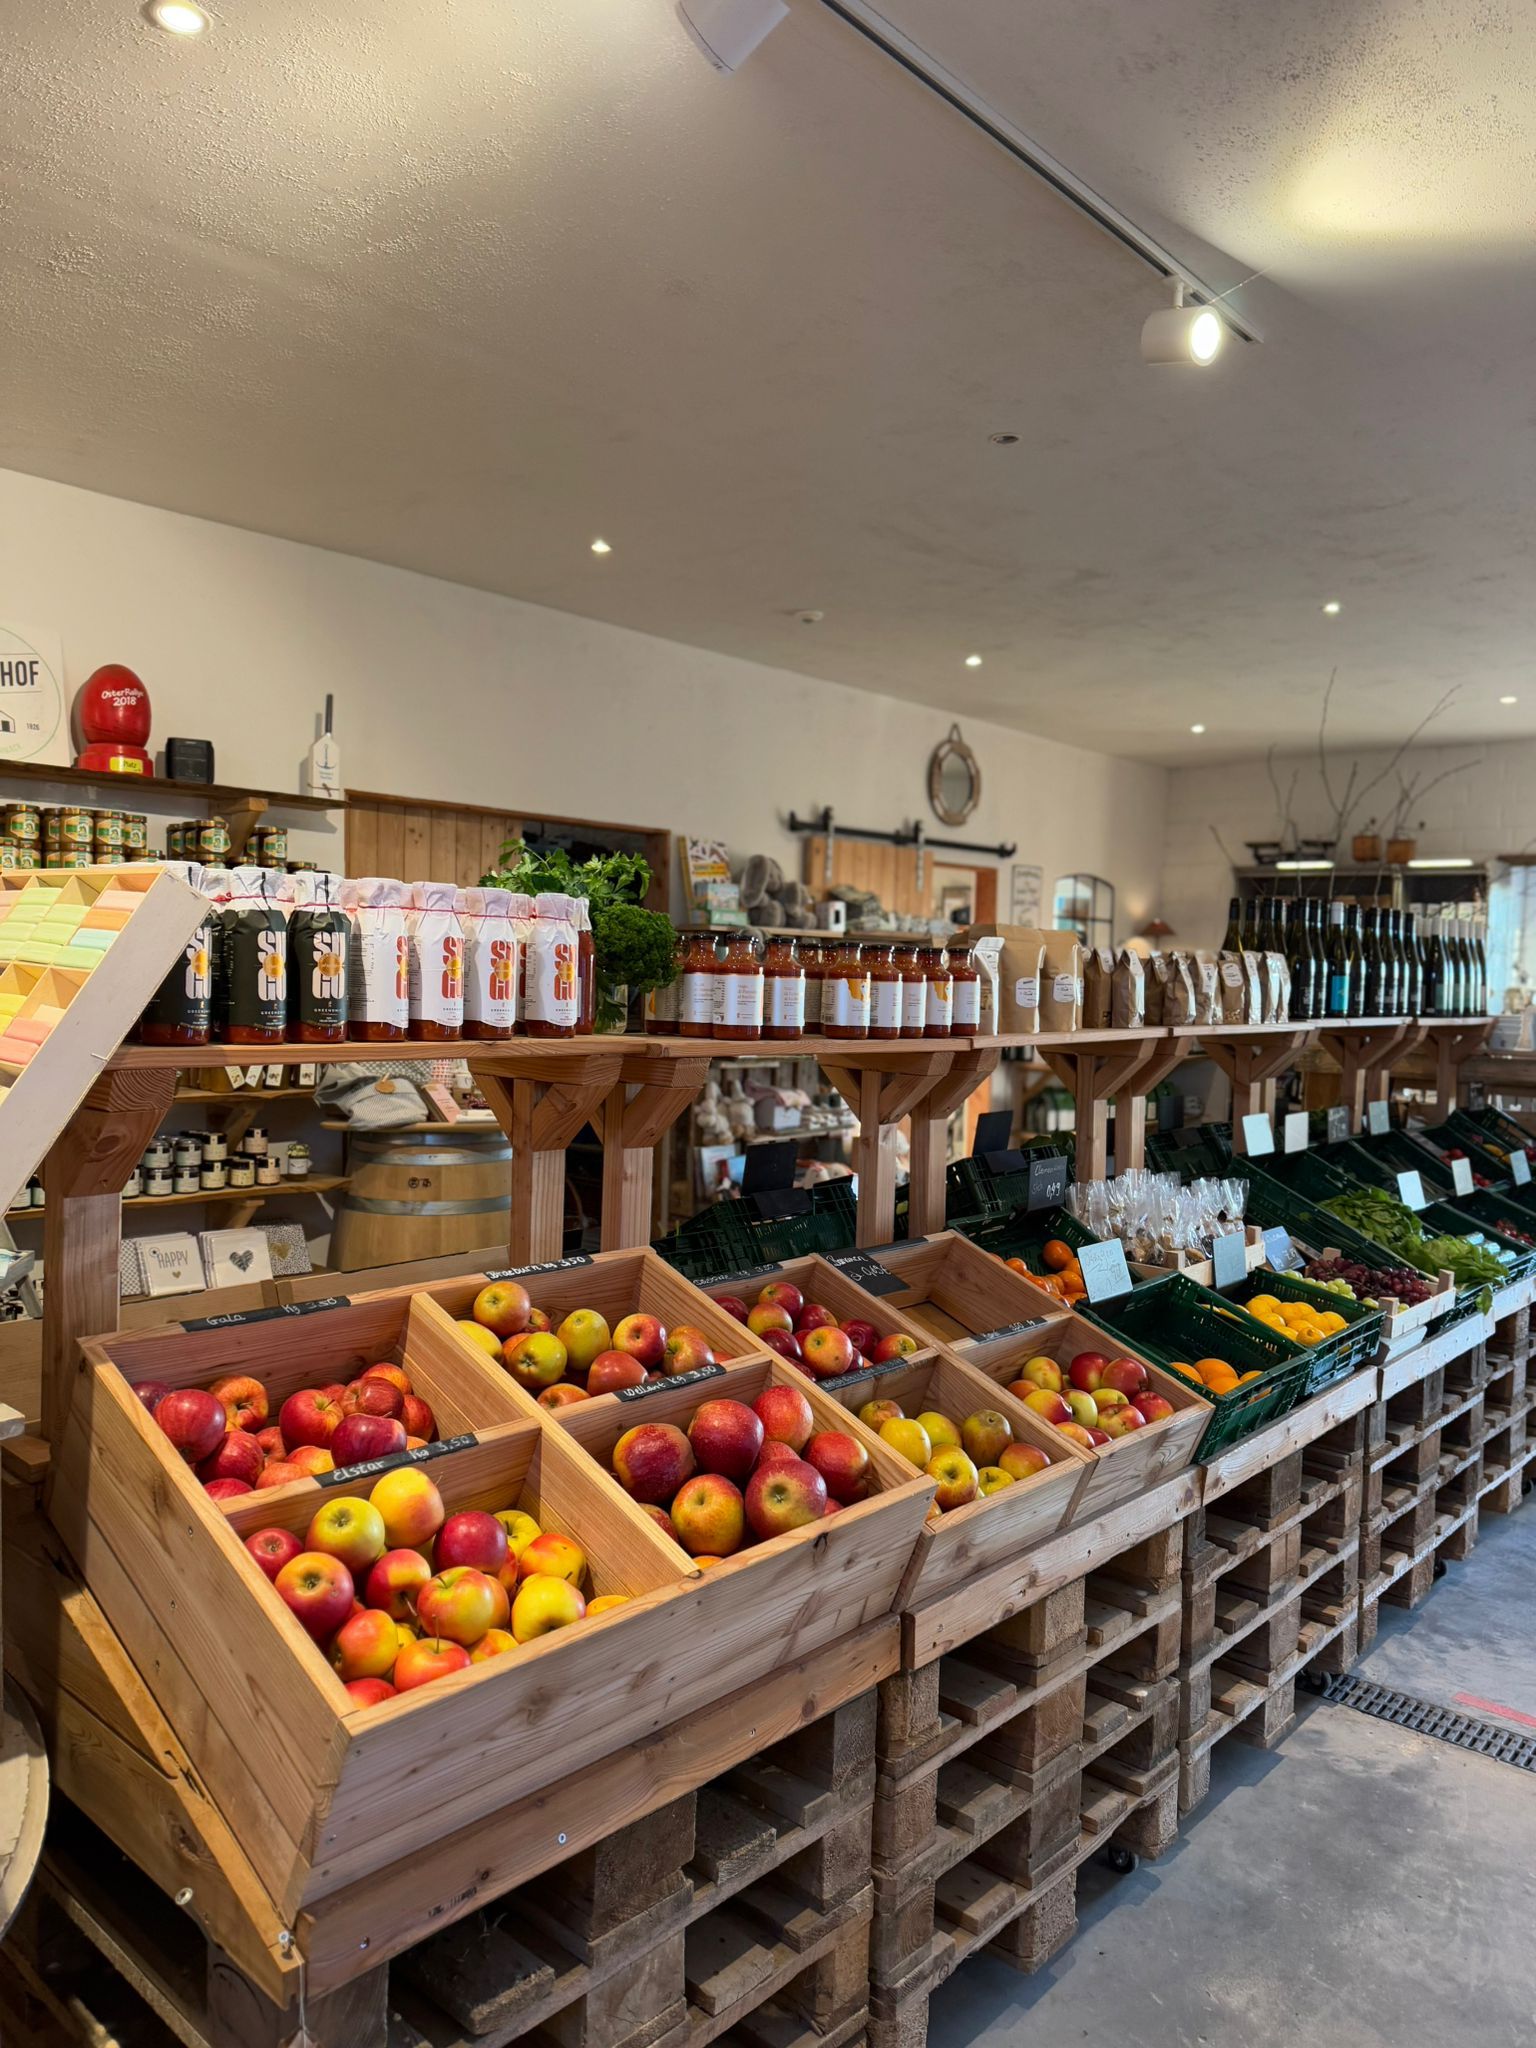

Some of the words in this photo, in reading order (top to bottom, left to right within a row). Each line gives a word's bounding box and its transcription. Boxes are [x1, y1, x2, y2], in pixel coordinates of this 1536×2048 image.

[113, 696, 137, 706] 2018
[157, 1249, 189, 1269] HAPPY
[486, 1264, 542, 1280] Braeburn
[206, 1313, 247, 1326] Gala
[333, 1459, 385, 1481] Elstar
